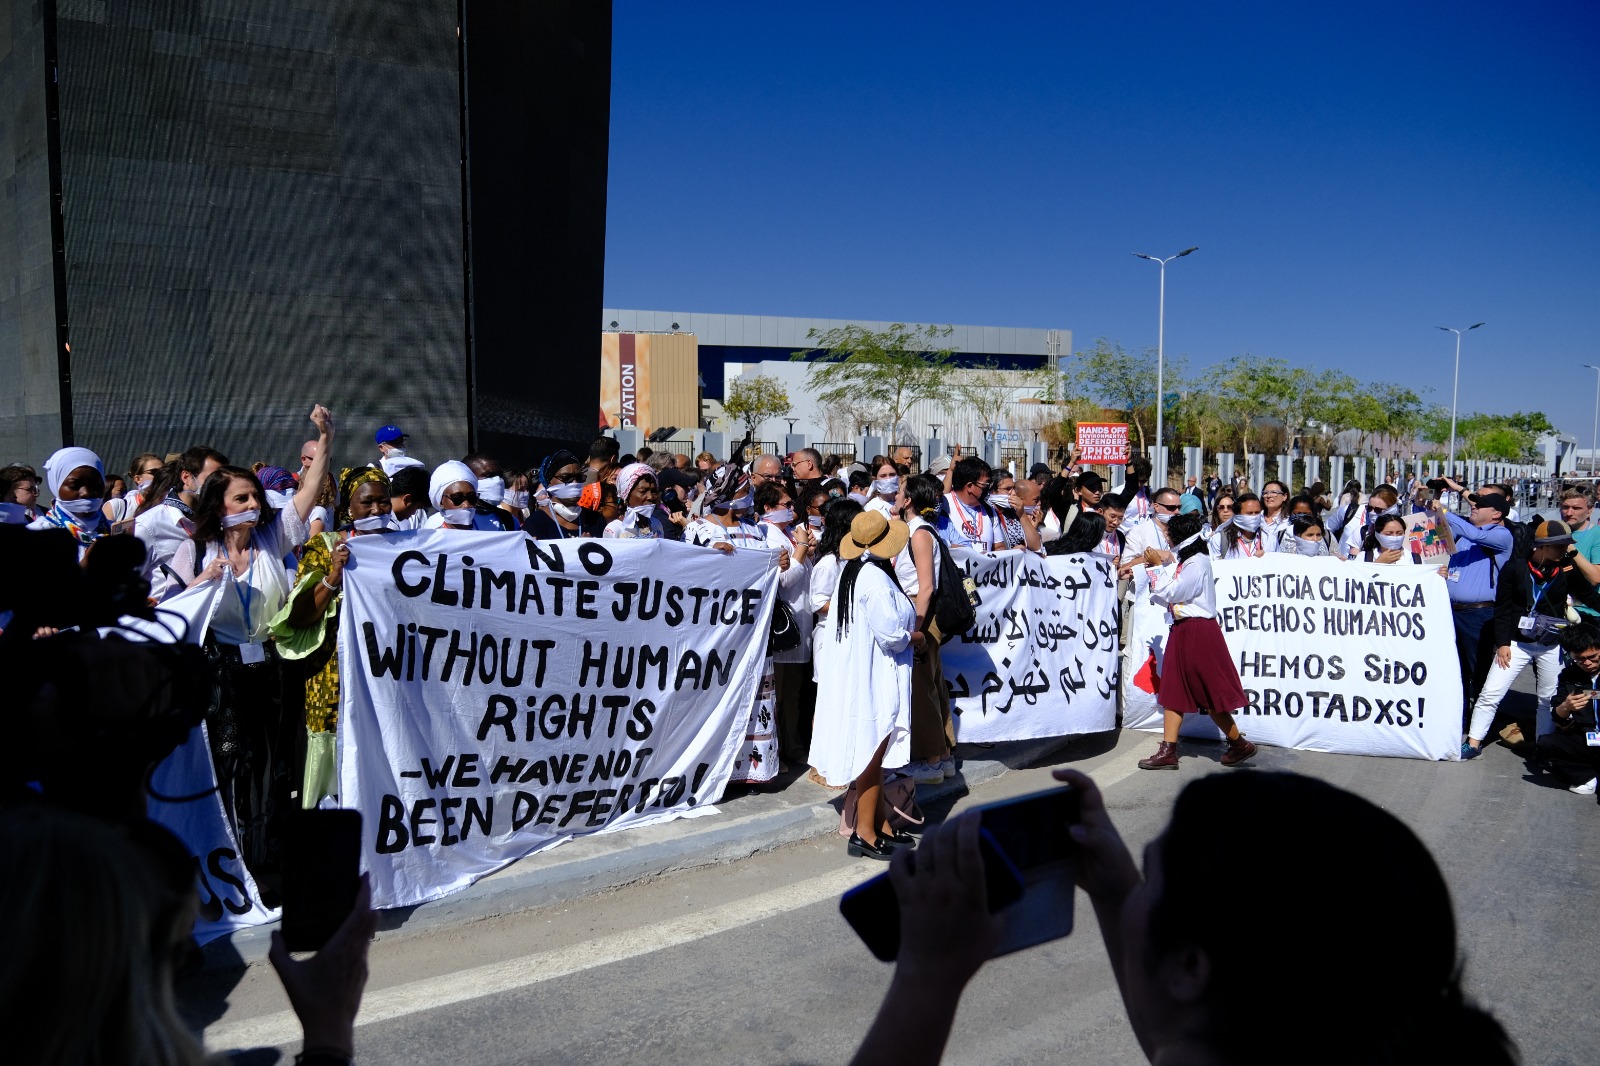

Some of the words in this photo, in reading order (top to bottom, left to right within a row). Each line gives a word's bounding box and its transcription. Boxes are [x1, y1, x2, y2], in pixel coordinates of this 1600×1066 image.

[622, 364, 635, 428] PTATION
[1079, 426, 1109, 434] HANDS
[526, 538, 613, 577] NO
[1095, 559, 1115, 589] لا
[1034, 607, 1078, 652] حقوق
[1323, 606, 1426, 641] HUMANOS
[579, 640, 737, 692] HUMAN
[1060, 654, 1087, 705] لم
[1240, 650, 1346, 681] HEMOS
[1199, 688, 1426, 729] RROTADXS!
[490, 752, 588, 785] HAVE
[587, 747, 654, 782] NOT
[375, 794, 494, 855] BEEN
